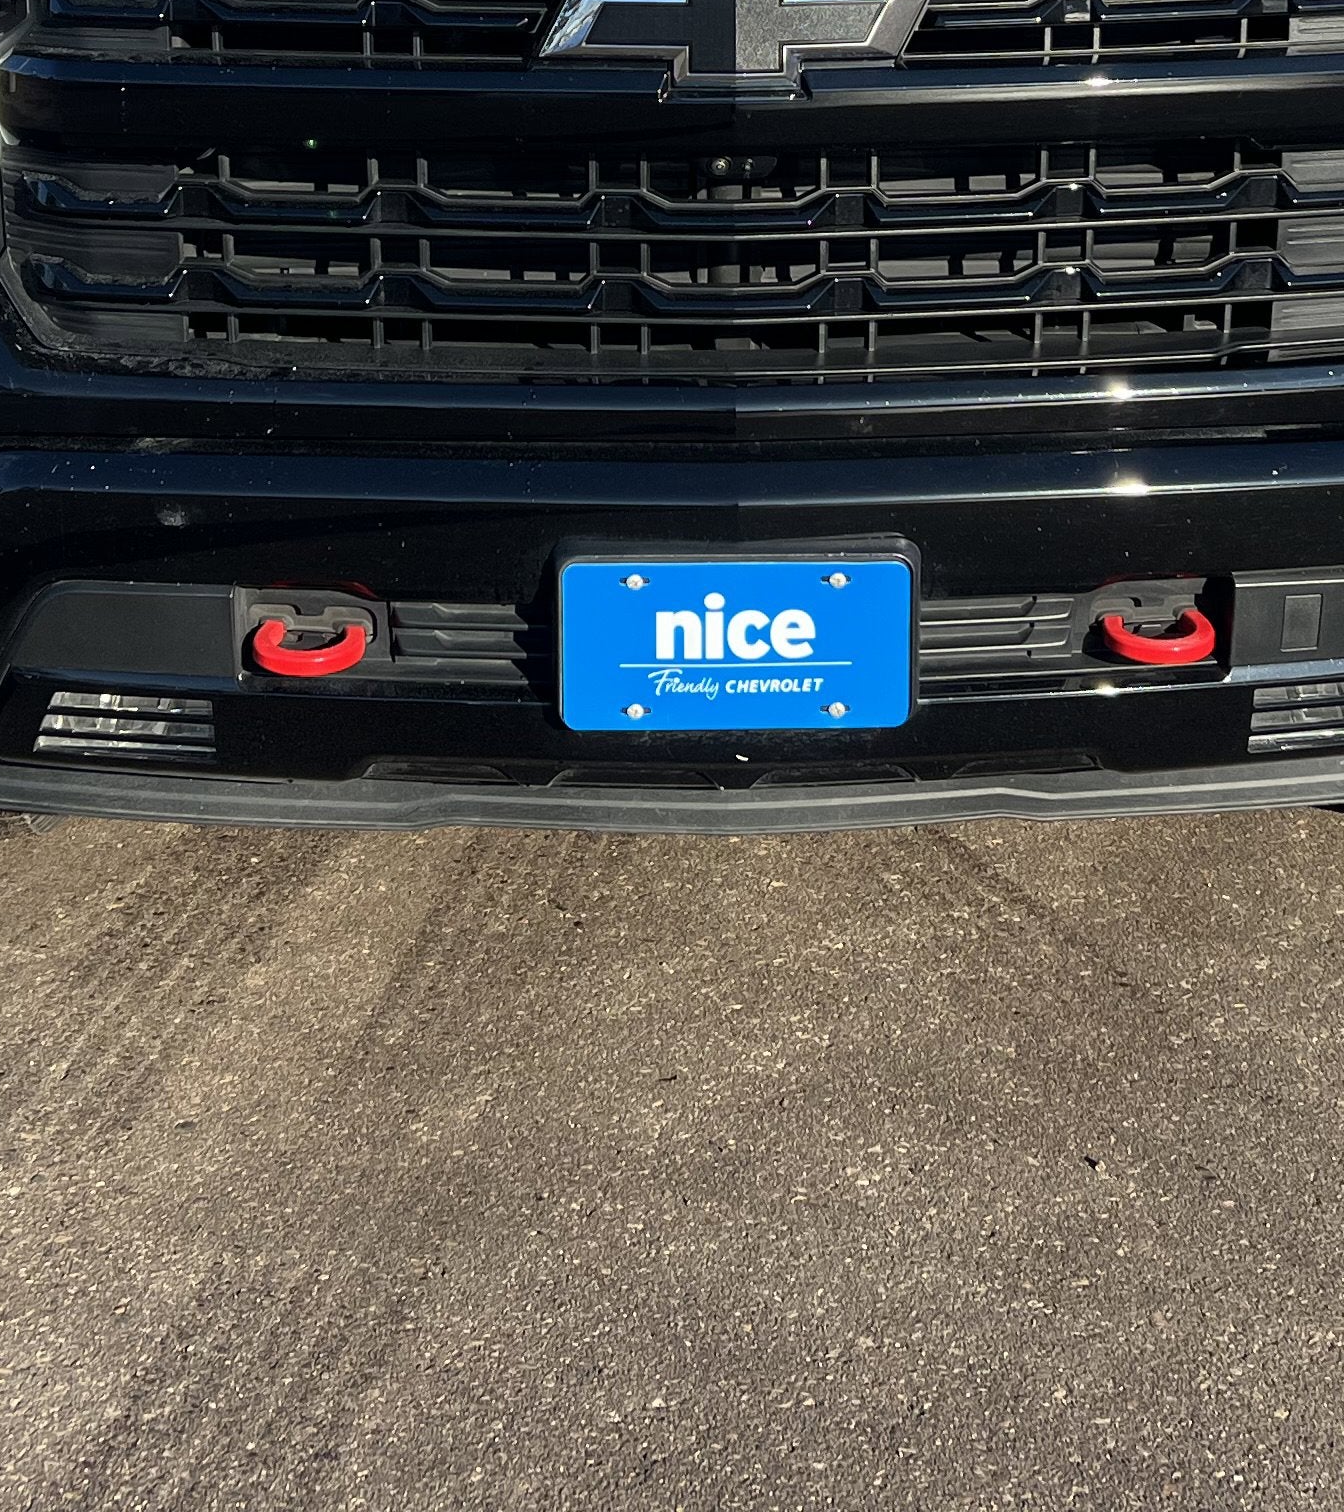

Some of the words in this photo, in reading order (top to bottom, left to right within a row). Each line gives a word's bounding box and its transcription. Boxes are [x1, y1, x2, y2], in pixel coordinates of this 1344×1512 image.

[655, 592, 816, 660] nice
[647, 669, 720, 700] Friendly
[725, 677, 824, 694] CHEVROLET
